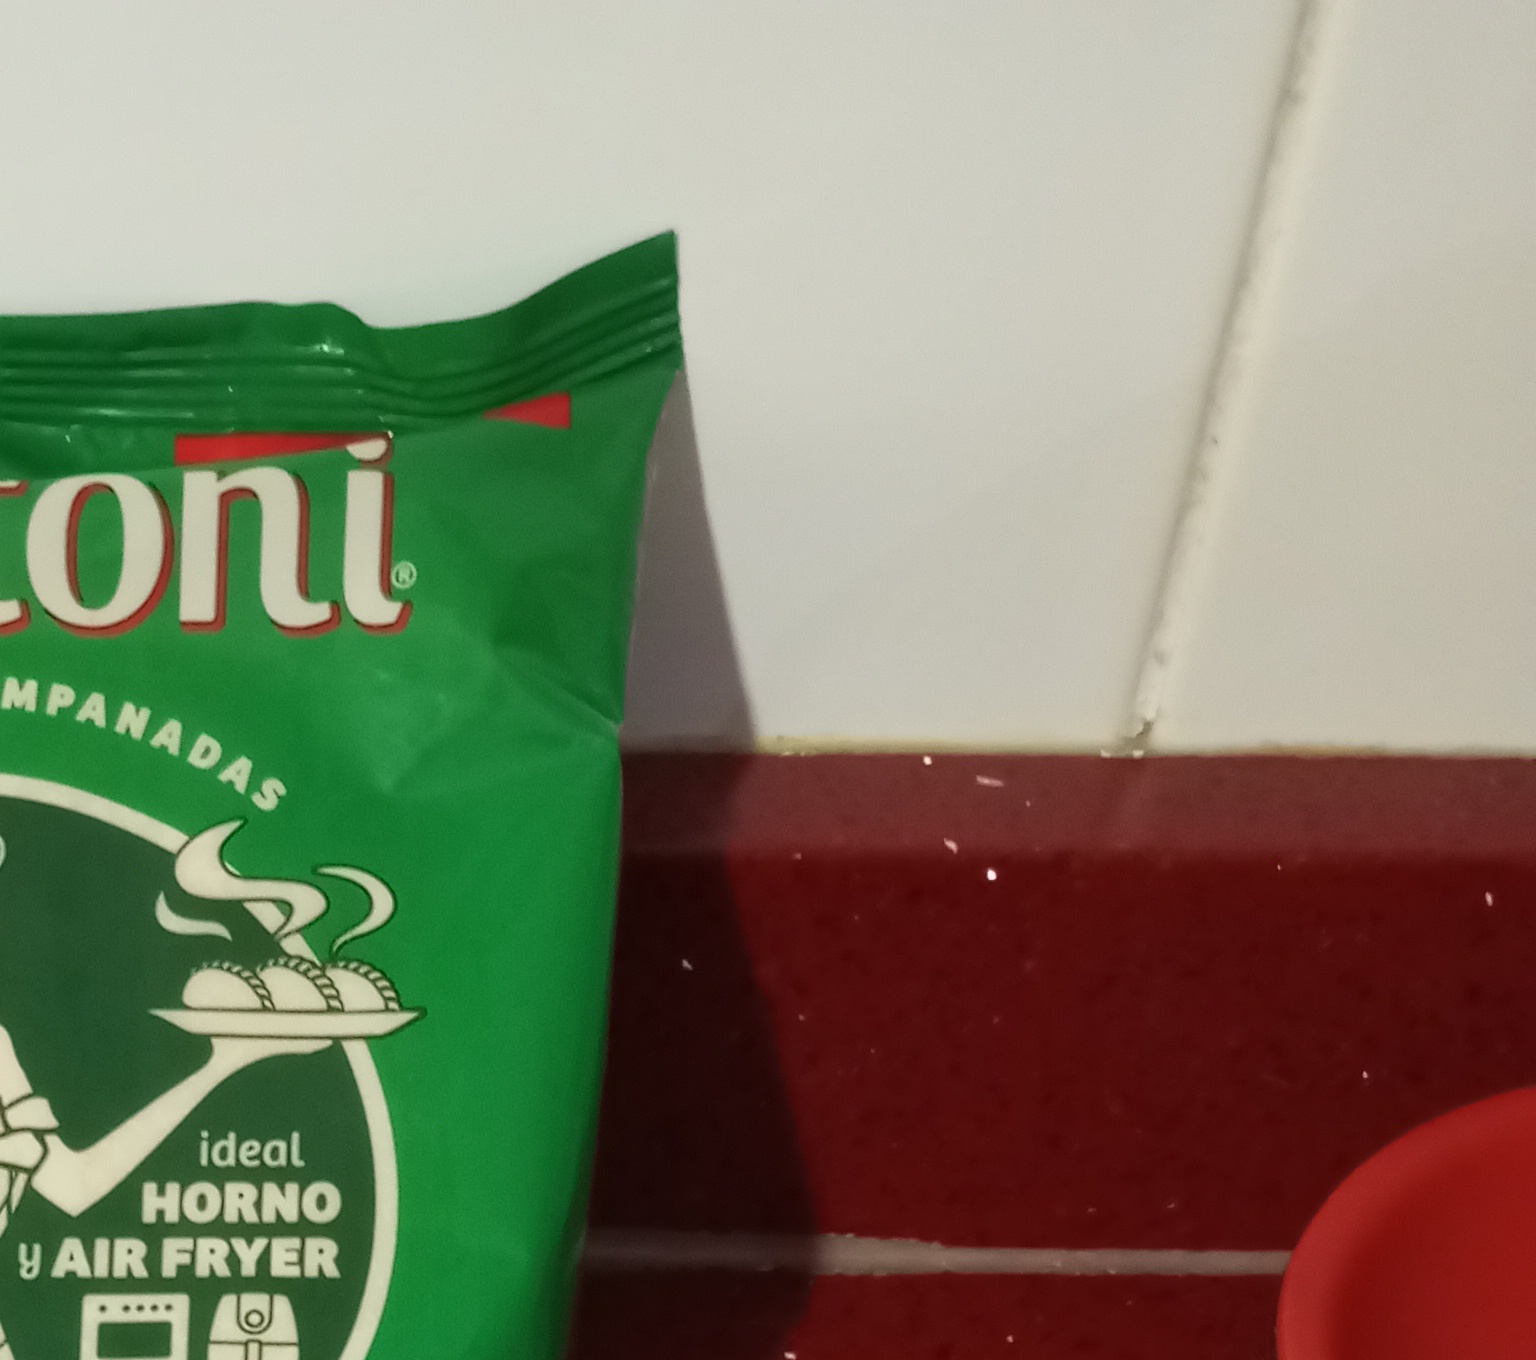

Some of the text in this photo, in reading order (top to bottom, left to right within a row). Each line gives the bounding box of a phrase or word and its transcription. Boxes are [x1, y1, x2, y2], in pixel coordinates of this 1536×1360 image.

[199, 1131, 305, 1168] ideal
[141, 1181, 342, 1225] HORNO
[17, 1236, 341, 1281] y AIR FRYER
